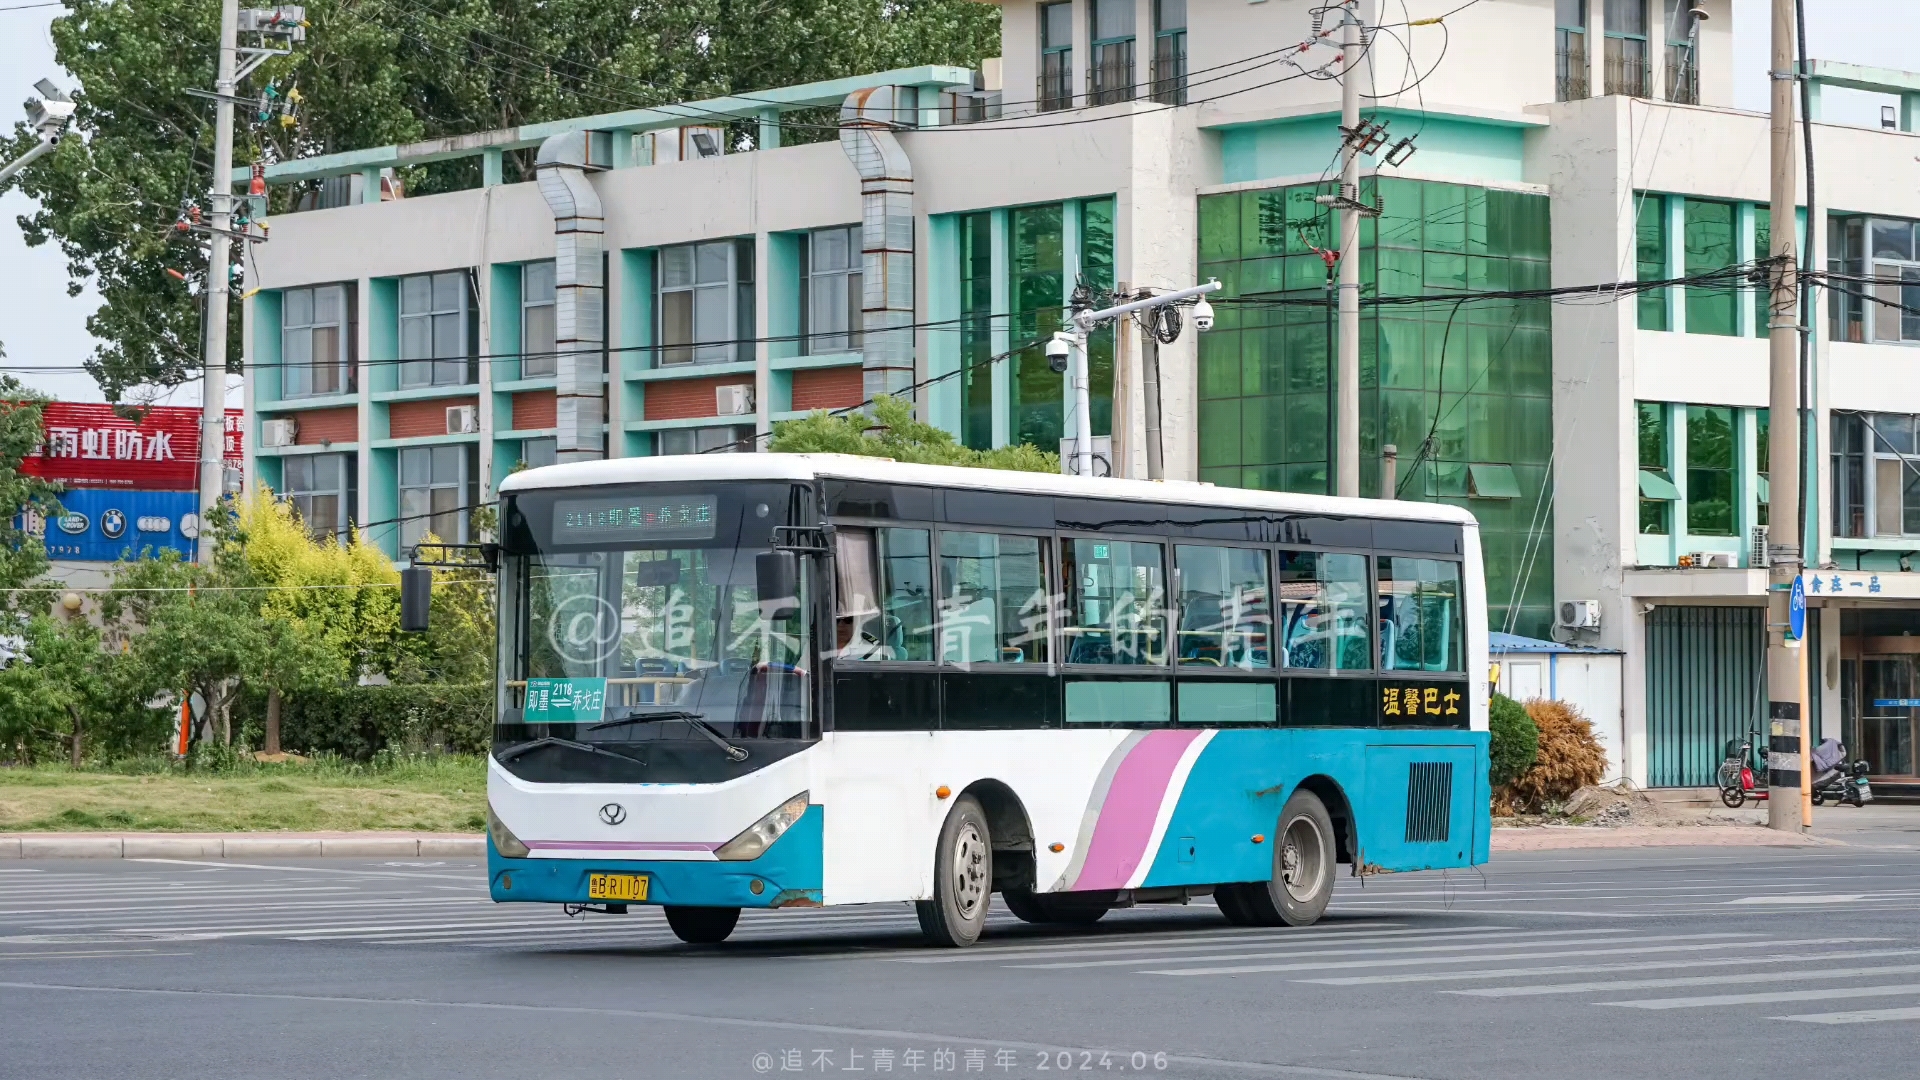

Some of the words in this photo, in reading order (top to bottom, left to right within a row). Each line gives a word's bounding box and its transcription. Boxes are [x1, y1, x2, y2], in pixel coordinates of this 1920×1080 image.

[1810, 573, 1882, 594] 食在一品
[527, 689, 549, 711] 即墨
[572, 689, 602, 711] 乔戈庄
[552, 683, 573, 696] 2118
